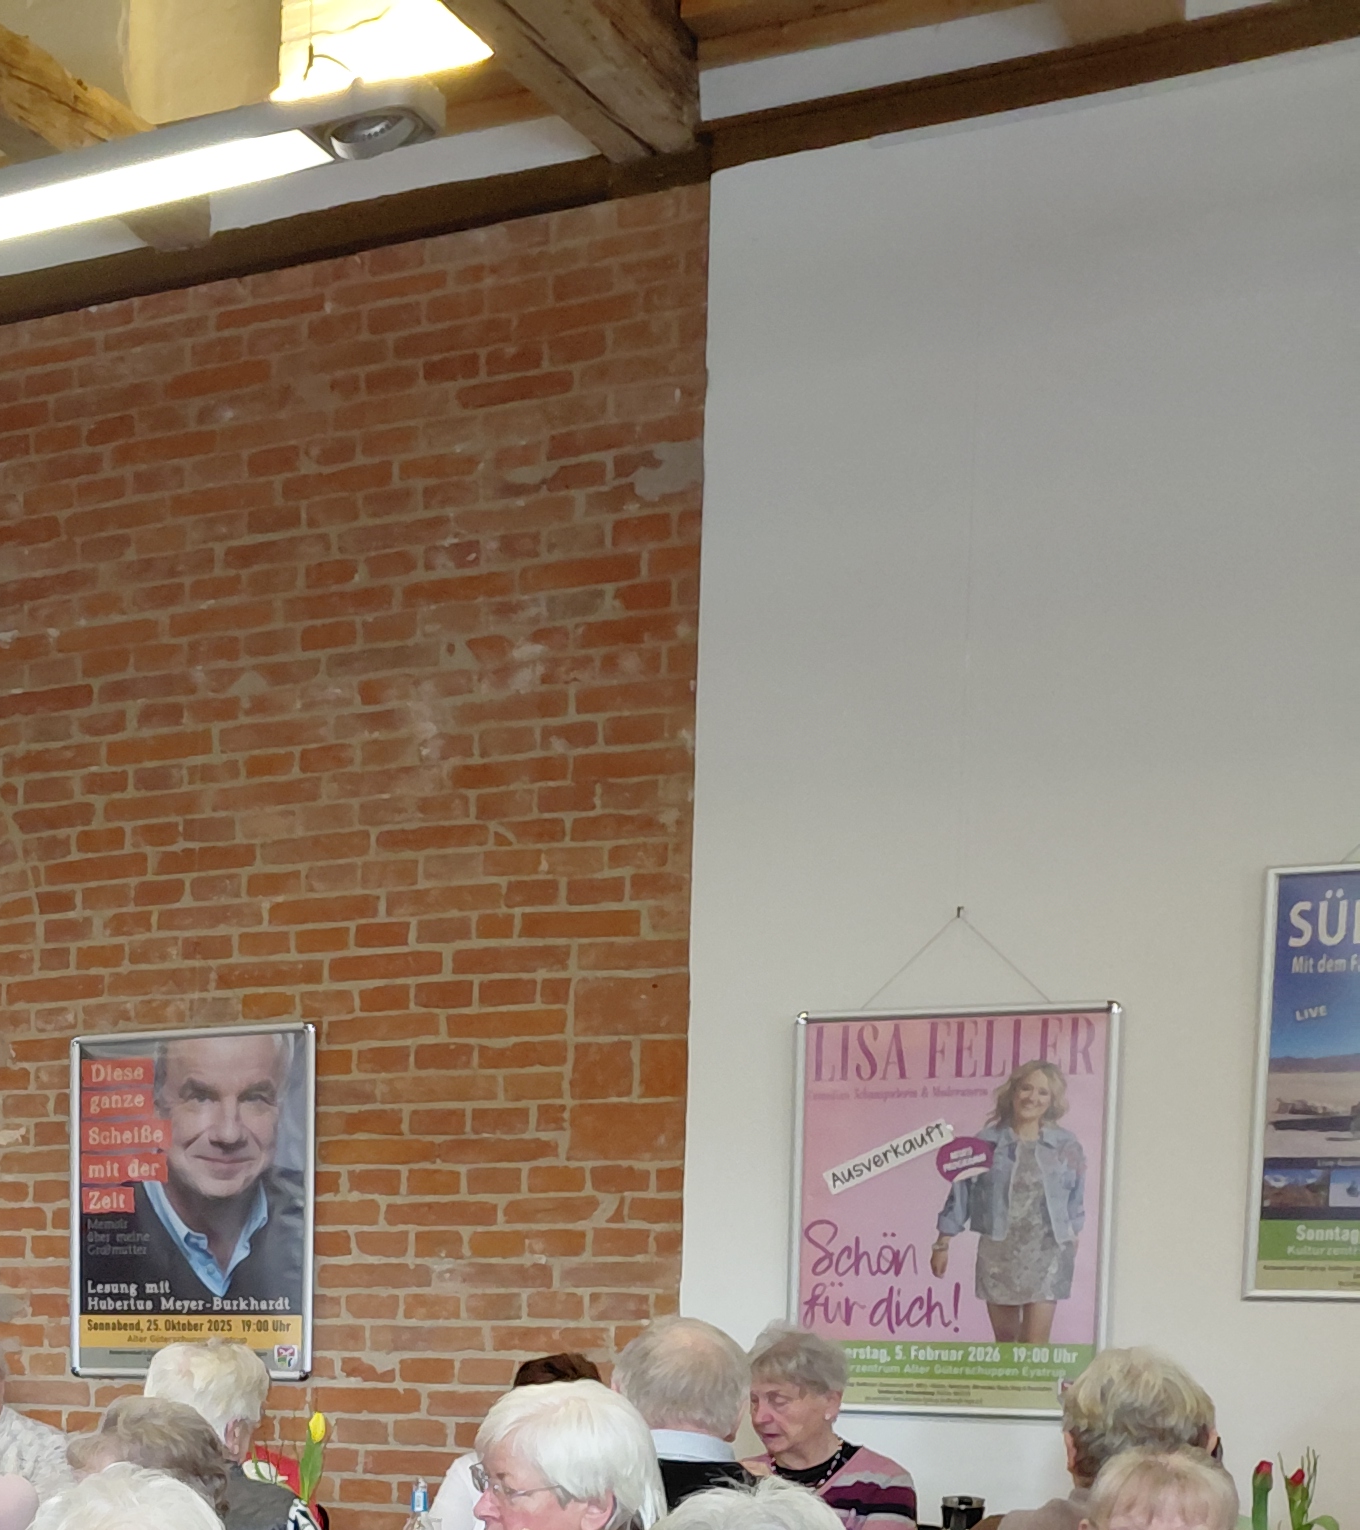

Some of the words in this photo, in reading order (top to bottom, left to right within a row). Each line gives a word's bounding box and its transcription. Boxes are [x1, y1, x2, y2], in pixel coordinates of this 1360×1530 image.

[1291, 955, 1314, 973] Mit
[1317, 953, 1347, 973] dem
[1295, 1005, 1327, 1021] LIVE
[813, 1023, 908, 1082] LISA
[926, 1016, 1096, 1080] FELLER
[91, 1064, 144, 1082] Diese
[90, 1094, 145, 1114] ganze
[88, 1125, 164, 1145] Scheiße
[831, 1122, 946, 1189] Ausverkauft
[88, 1161, 119, 1178] mit
[127, 1158, 161, 1178] der
[88, 1191, 126, 1211] Zeit
[804, 1219, 918, 1277] Schön
[87, 1280, 138, 1296] Lesung
[145, 1280, 171, 1294] mit
[87, 1296, 153, 1310] Hubertus
[160, 1296, 291, 1313] Meyer-Burkhardt
[803, 1281, 866, 1329] für
[869, 1282, 961, 1334] dich!
[87, 1319, 144, 1333] Sonnabend,
[164, 1319, 203, 1332] Oktober
[207, 1319, 232, 1332] 2025
[241, 1319, 269, 1332] 19:00
[272, 1319, 291, 1332] Uhr
[845, 1345, 891, 1363] erstag,
[894, 1345, 906, 1360] 5.
[911, 1346, 963, 1362] Februar
[968, 1347, 1000, 1363] 2026
[1012, 1347, 1050, 1363] 19:00
[1053, 1347, 1079, 1364] Uhr
